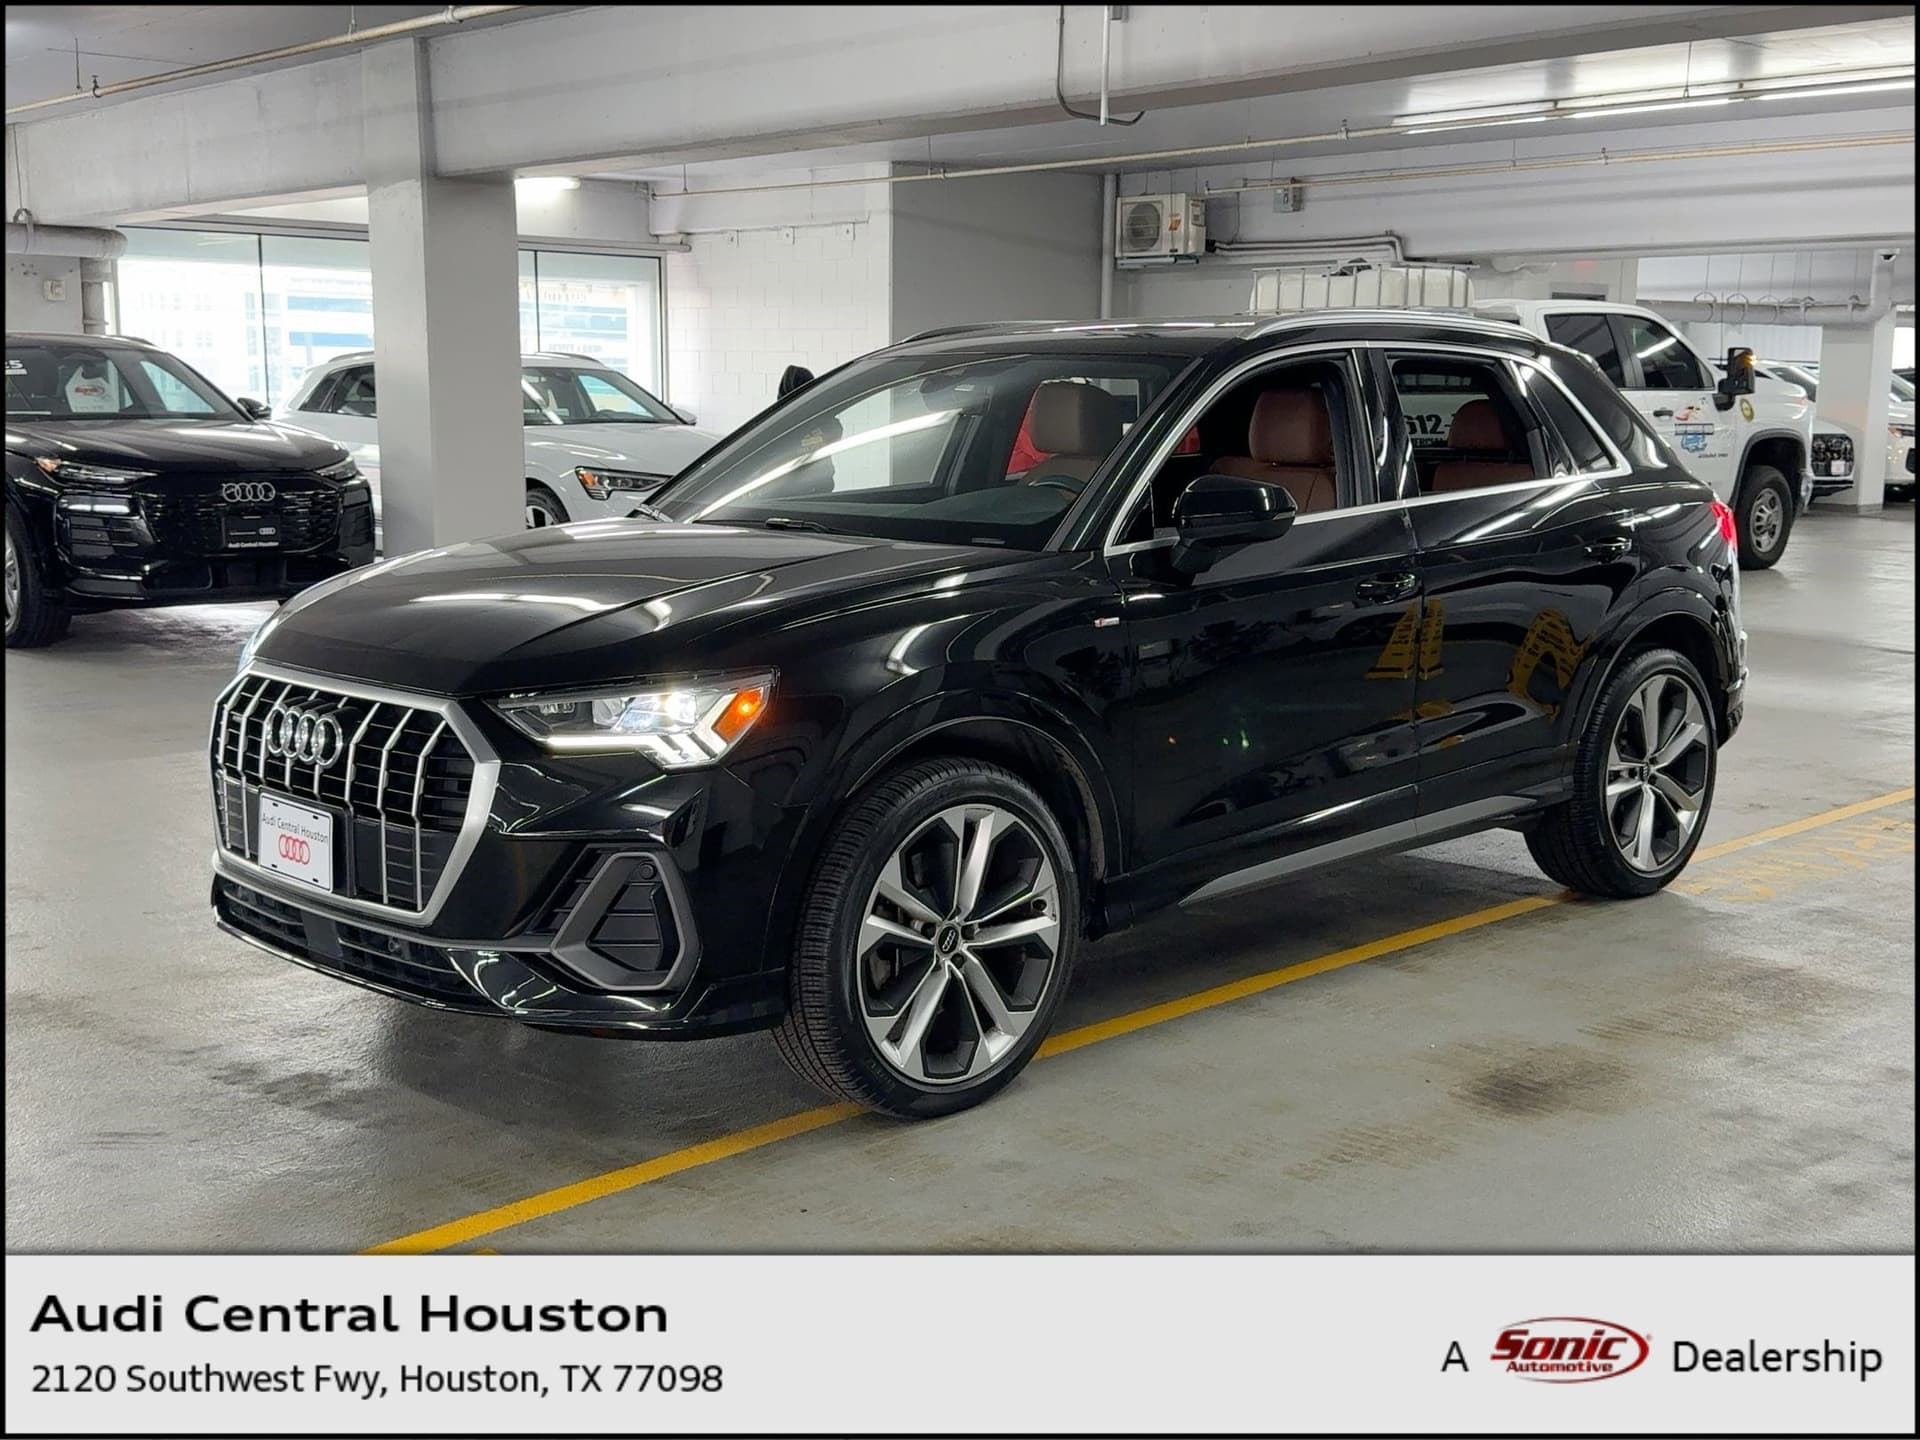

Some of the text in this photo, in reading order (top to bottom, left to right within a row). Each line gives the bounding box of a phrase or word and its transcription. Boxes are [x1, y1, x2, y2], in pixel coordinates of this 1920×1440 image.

[262, 813, 329, 843] Audi Central Houston
